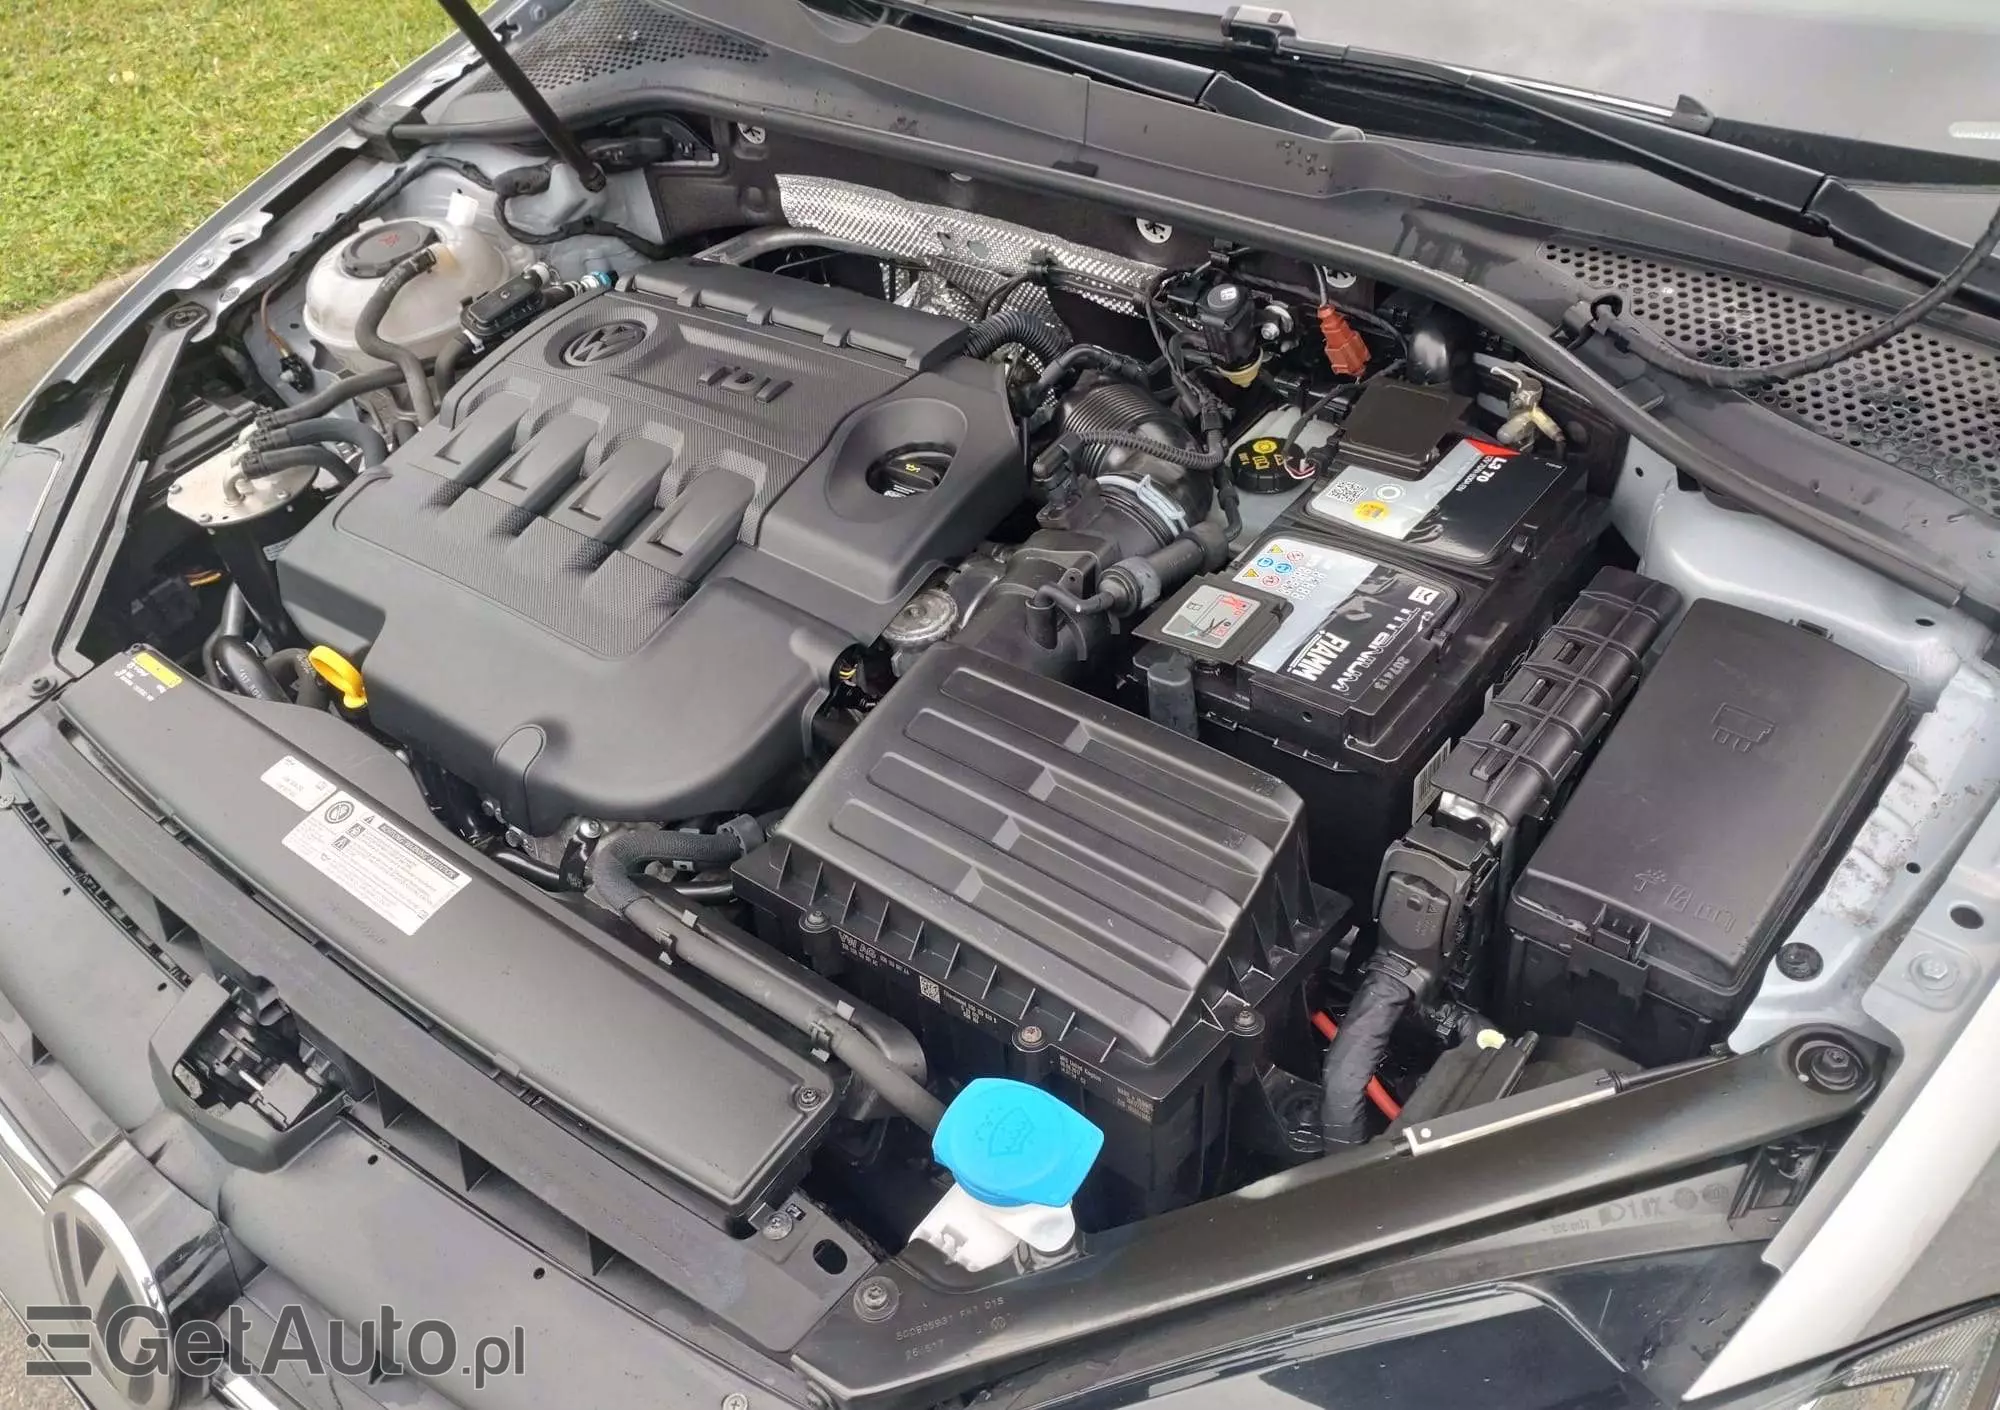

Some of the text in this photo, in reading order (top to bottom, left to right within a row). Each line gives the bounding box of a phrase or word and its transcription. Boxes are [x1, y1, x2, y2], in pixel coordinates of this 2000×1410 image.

[697, 359, 794, 404] TDI
[1476, 456, 1507, 482] L3 70
[1292, 632, 1351, 681] FIAMM
